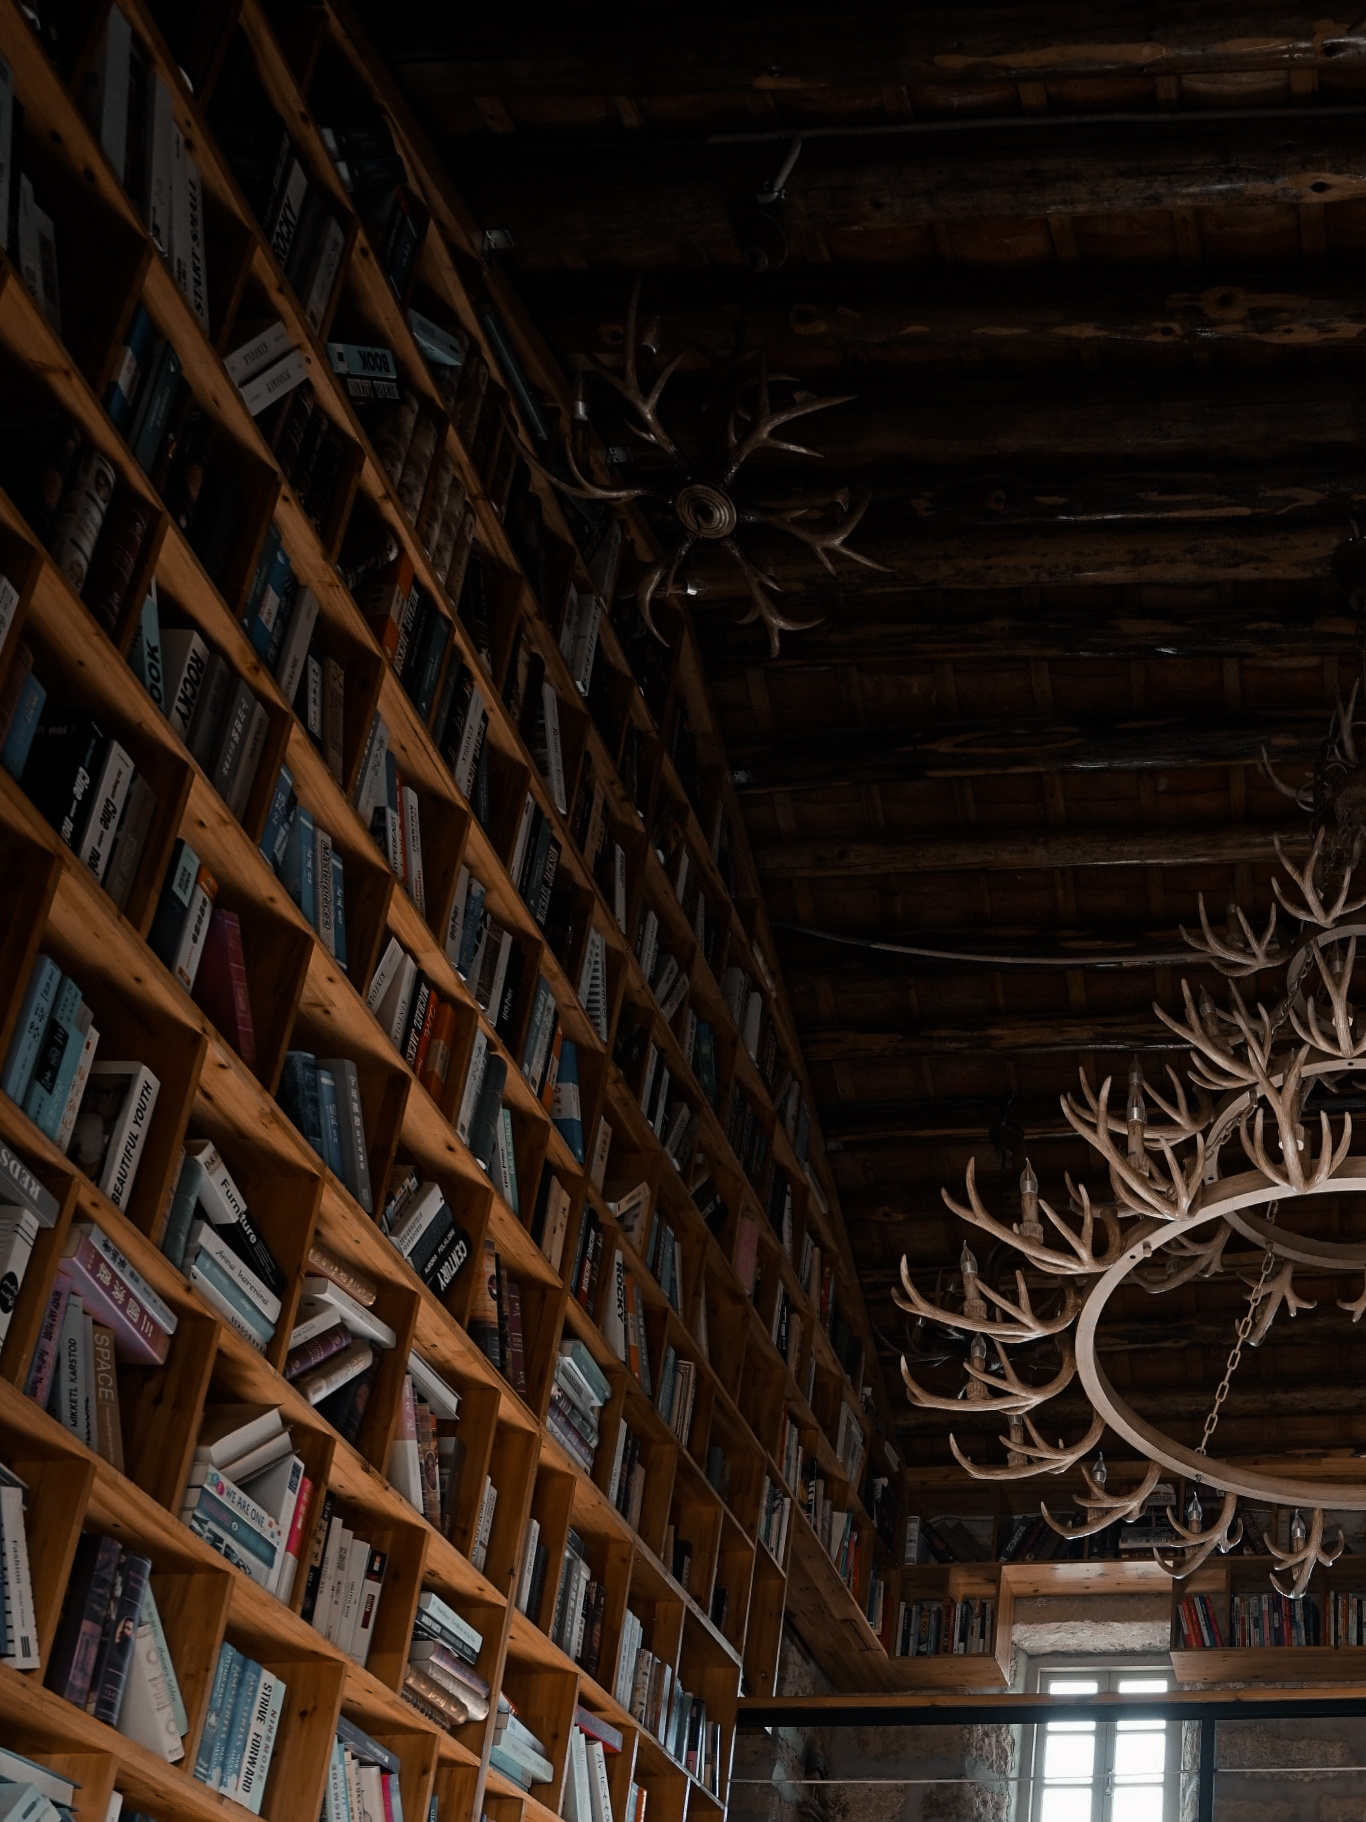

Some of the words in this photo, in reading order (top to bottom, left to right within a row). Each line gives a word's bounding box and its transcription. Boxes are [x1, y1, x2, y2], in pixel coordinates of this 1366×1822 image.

[187, 179, 200, 244] SMALL
[189, 249, 205, 317] START
[358, 350, 391, 373] BOOK
[175, 648, 205, 729] ROCKY
[98, 797, 117, 831] Cine
[413, 982, 429, 1030] MICHAEL
[111, 1132, 139, 1206] BEAUTIFUL
[133, 1080, 153, 1128] YOUTH
[220, 1178, 258, 1244] Furniture
[436, 1240, 468, 1292] CENTURY
[615, 1262, 624, 1324] ROCKY
[94, 1332, 115, 1402] SPACE
[225, 1488, 237, 1503] WE
[237, 1495, 250, 1513] ARE
[250, 1505, 265, 1528] ONE
[256, 1682, 273, 1725] STRIVE
[241, 1731, 262, 1794] FORWARD
